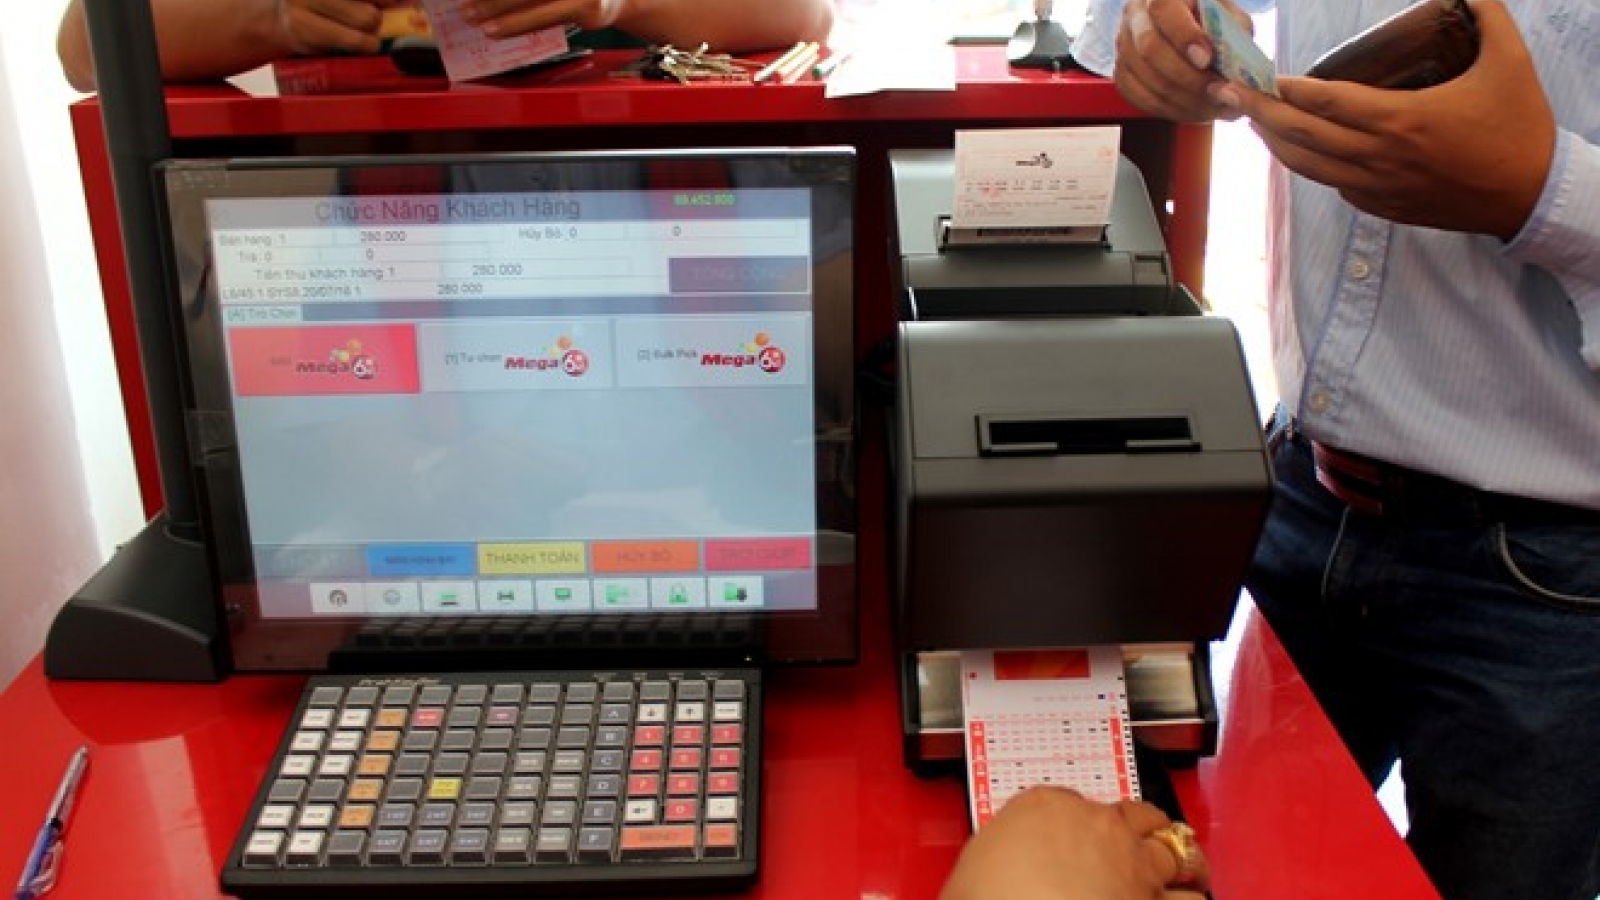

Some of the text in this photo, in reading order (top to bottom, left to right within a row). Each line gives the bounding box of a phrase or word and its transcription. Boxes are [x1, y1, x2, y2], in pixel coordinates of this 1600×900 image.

[366, 248, 374, 260] 0
[504, 357, 559, 370] Mega
[701, 354, 756, 367] Mega
